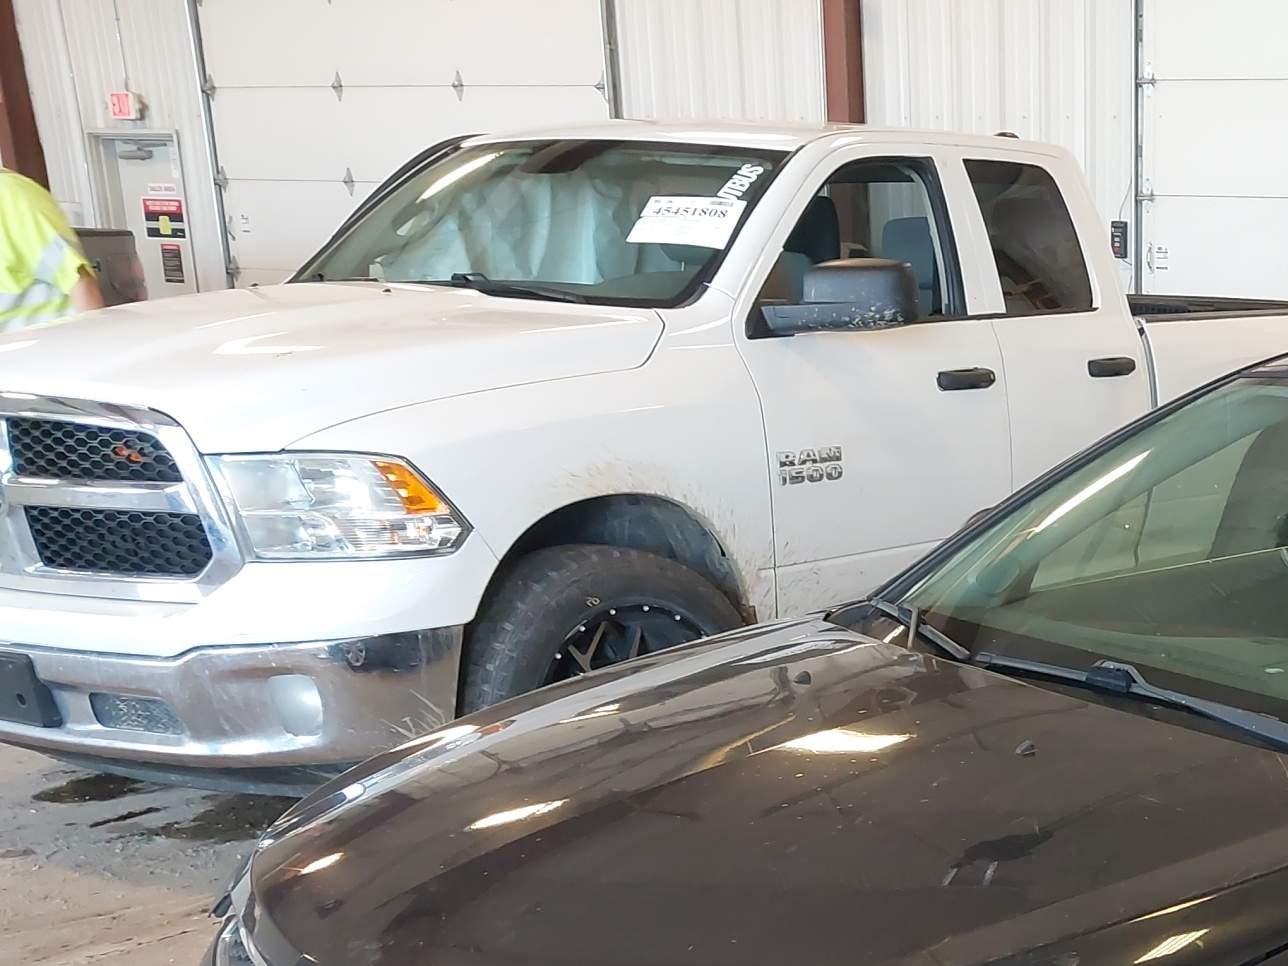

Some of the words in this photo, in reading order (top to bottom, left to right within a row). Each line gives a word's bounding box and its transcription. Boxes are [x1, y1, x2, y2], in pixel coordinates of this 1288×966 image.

[652, 206, 729, 218] 45451808
[776, 446, 842, 468] RAM
[778, 464, 843, 486] 1500
